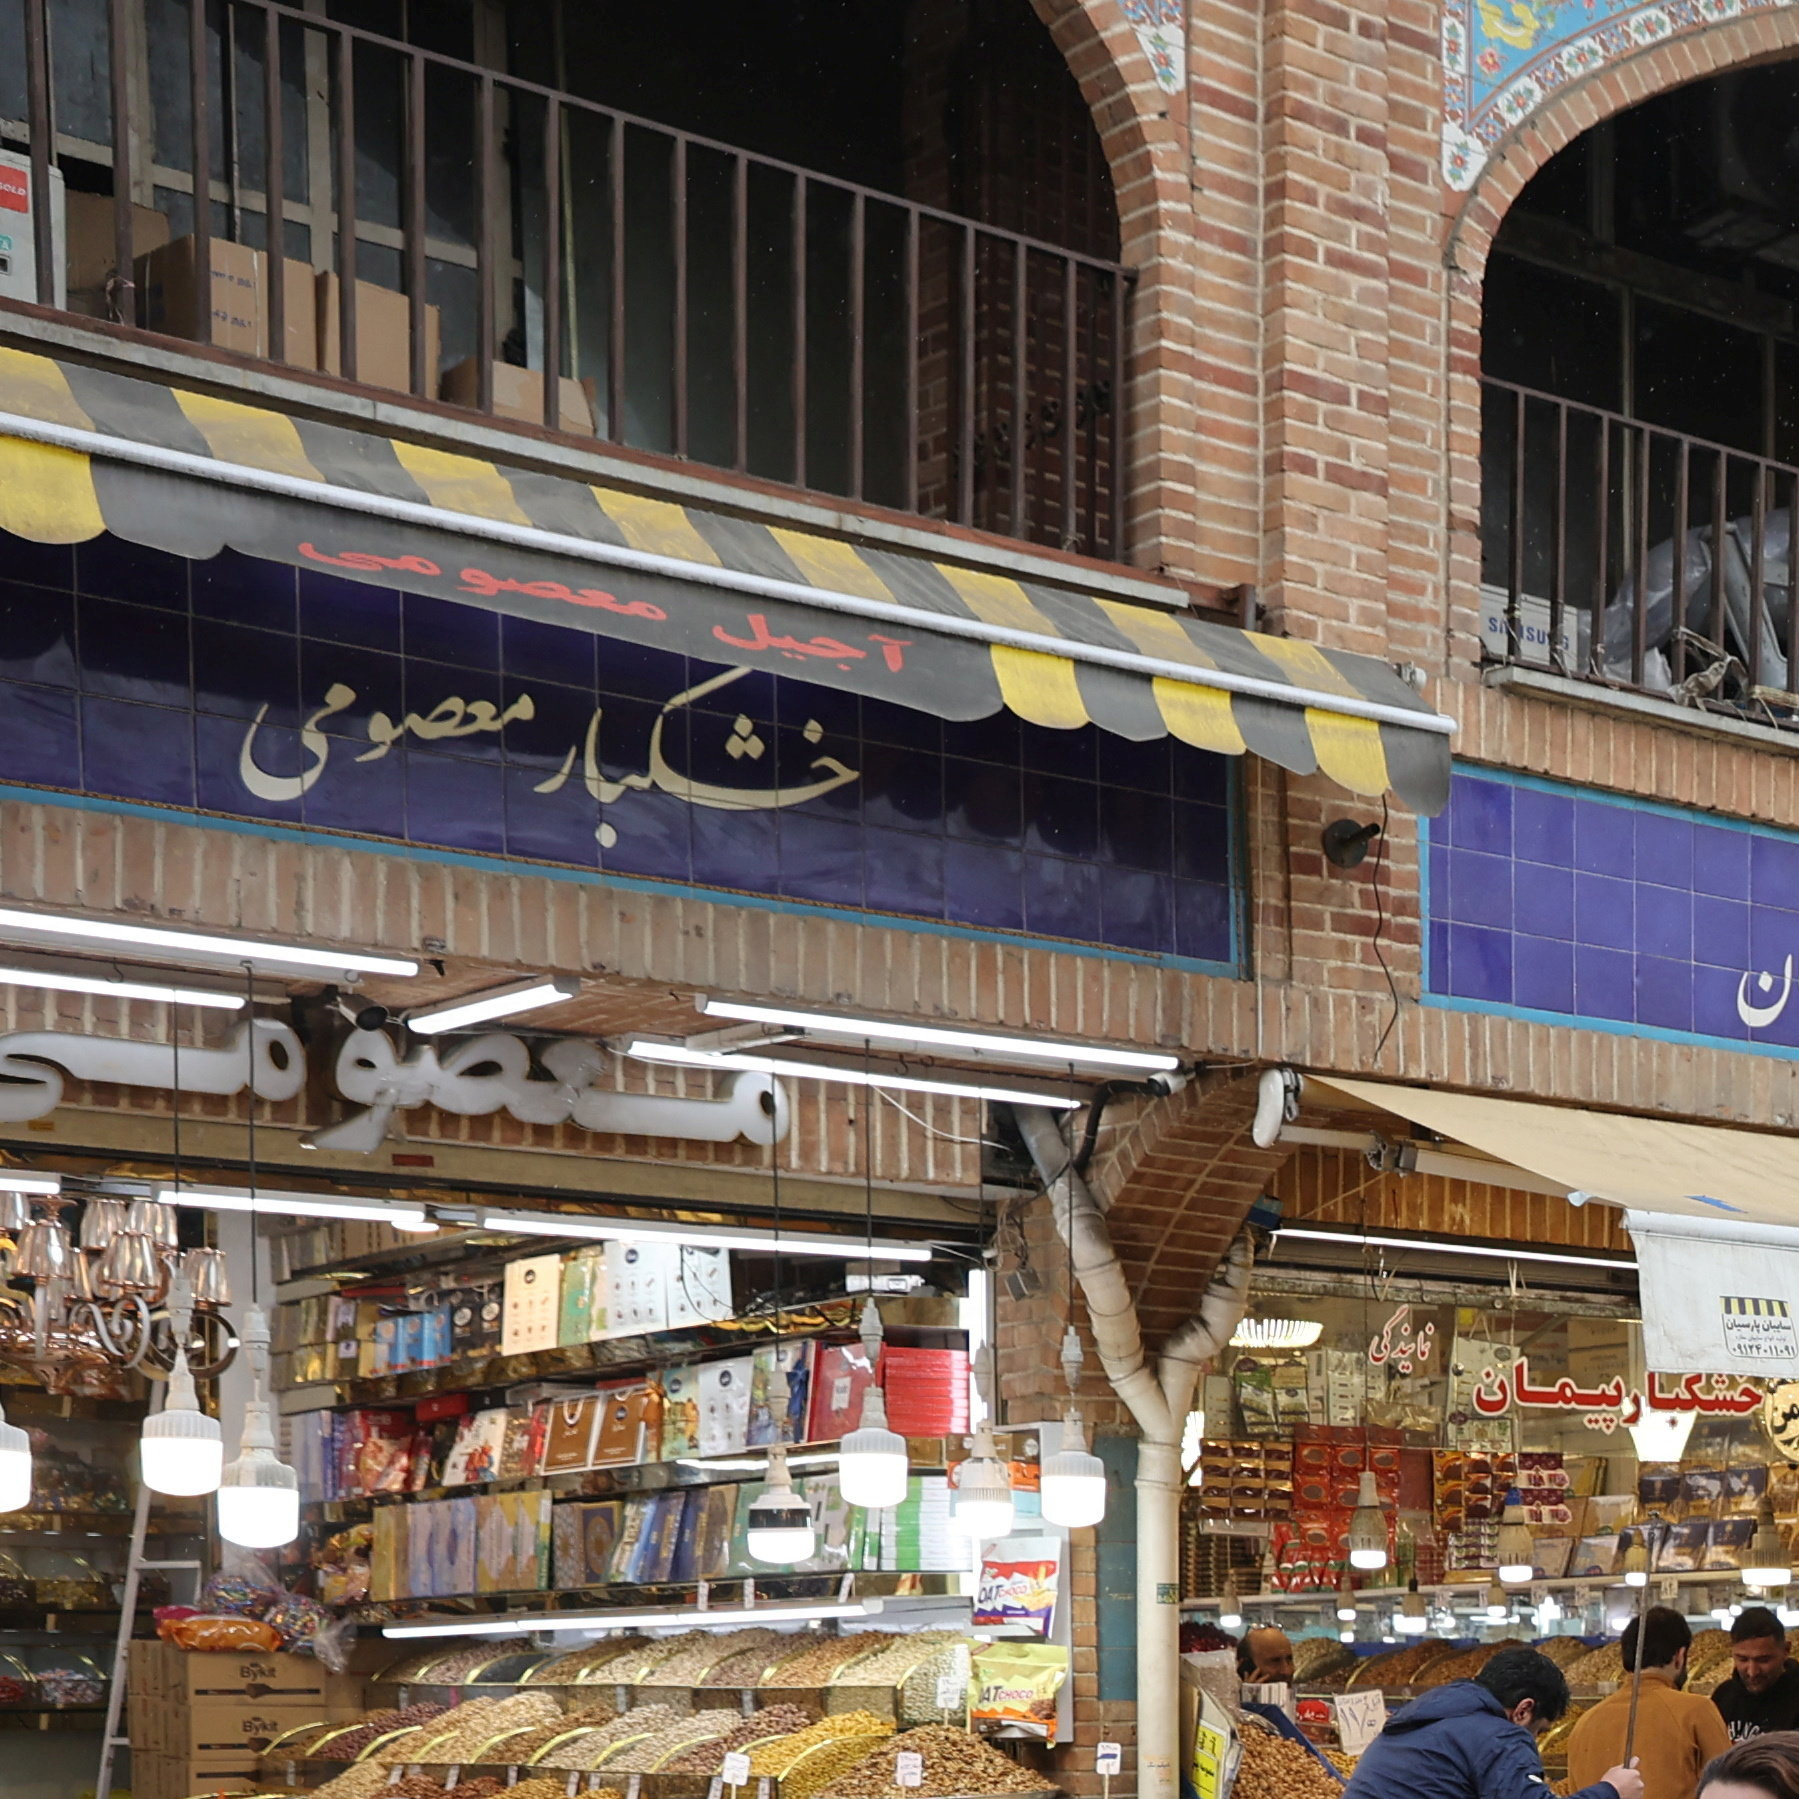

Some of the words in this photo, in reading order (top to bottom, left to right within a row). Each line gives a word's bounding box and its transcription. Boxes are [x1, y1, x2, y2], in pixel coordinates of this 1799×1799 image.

[712, 612, 916, 673] آجیل
[238, 683, 536, 802] معصومی
[533, 667, 862, 849] خشکبار
[1368, 1303, 1436, 1373] نمایندگی
[1726, 1318, 1761, 1334] پارسیان
[1472, 1356, 1624, 1436] پیمان
[1624, 1371, 1765, 1428] خشکبار
[240, 1666, 277, 1681] Bykit
[242, 1719, 279, 1735] Bykit
